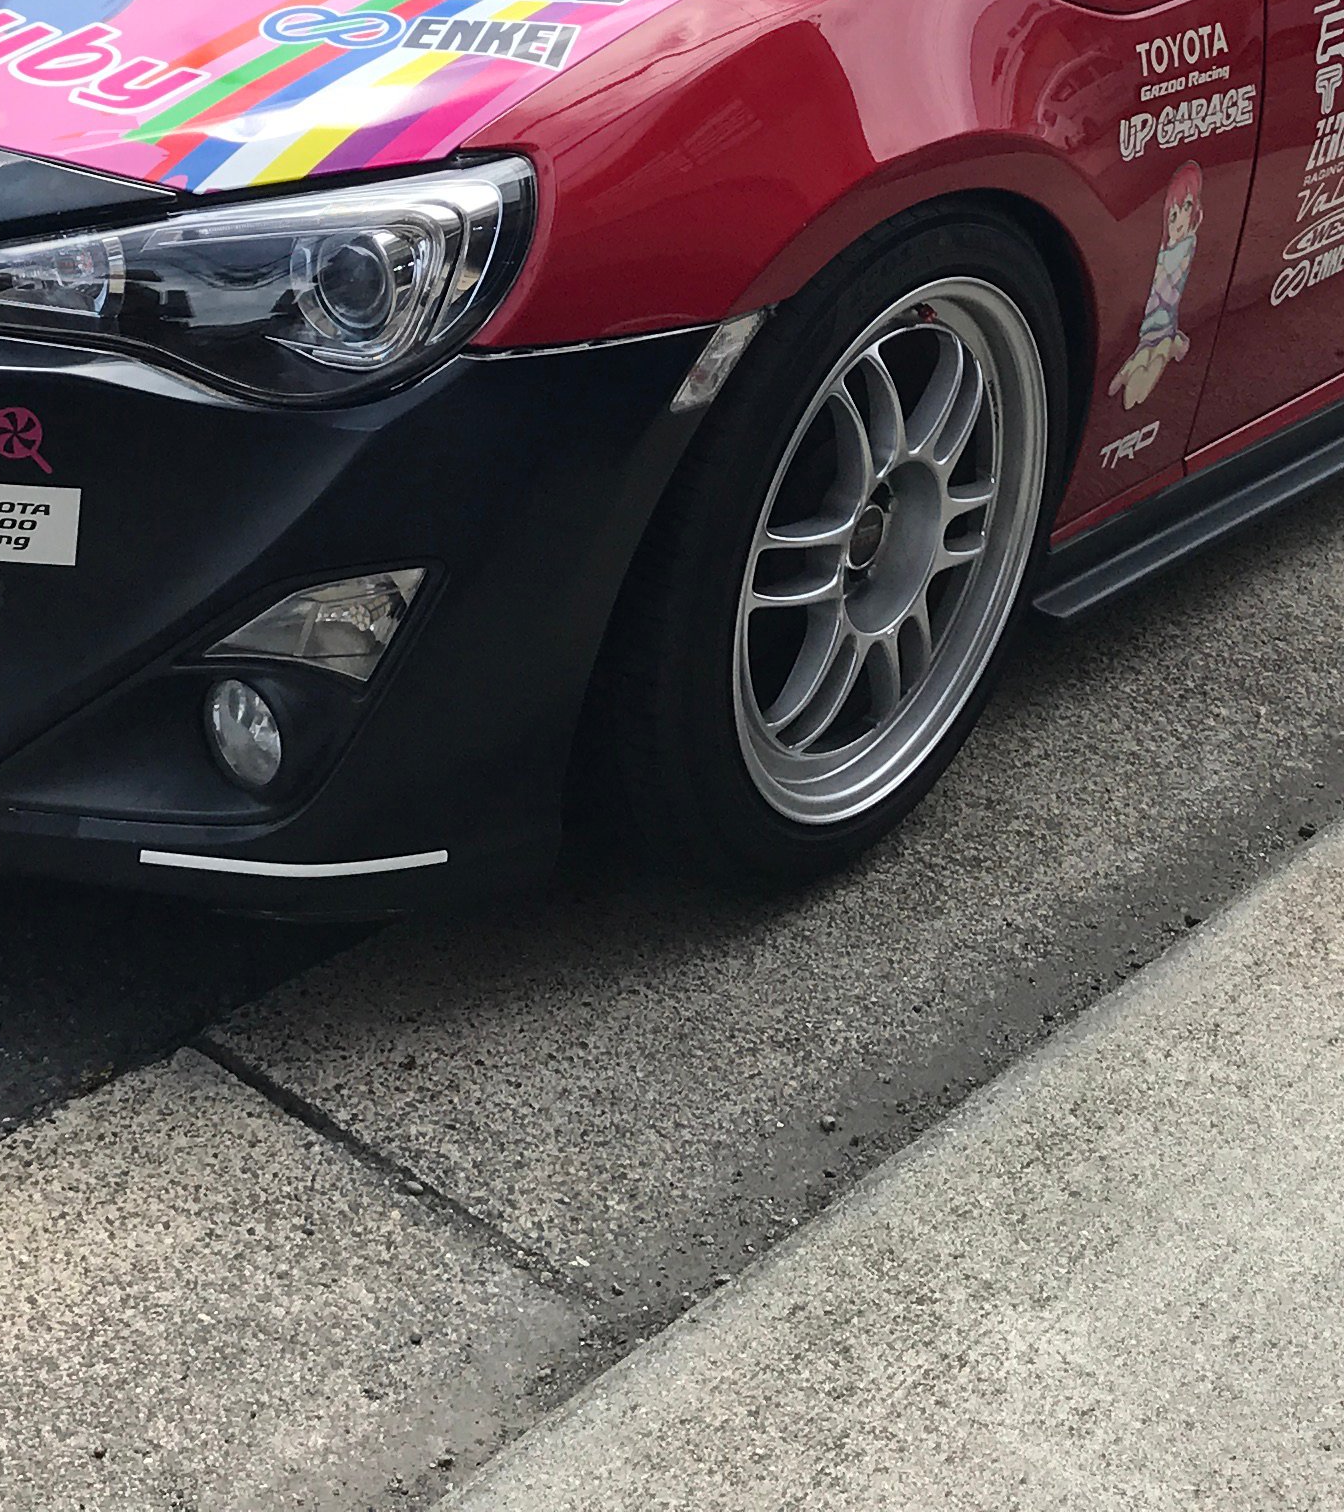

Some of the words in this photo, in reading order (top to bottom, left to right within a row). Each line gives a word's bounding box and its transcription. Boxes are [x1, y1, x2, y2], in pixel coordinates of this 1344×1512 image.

[403, 16, 582, 70] ENKEI
[1136, 22, 1229, 76] TOYOTA
[1188, 66, 1230, 87] Racing
[1120, 113, 1156, 161] UP
[1157, 84, 1256, 148] GARAGE
[1303, 160, 1344, 186] RACING
[1099, 420, 1160, 469] TRD
